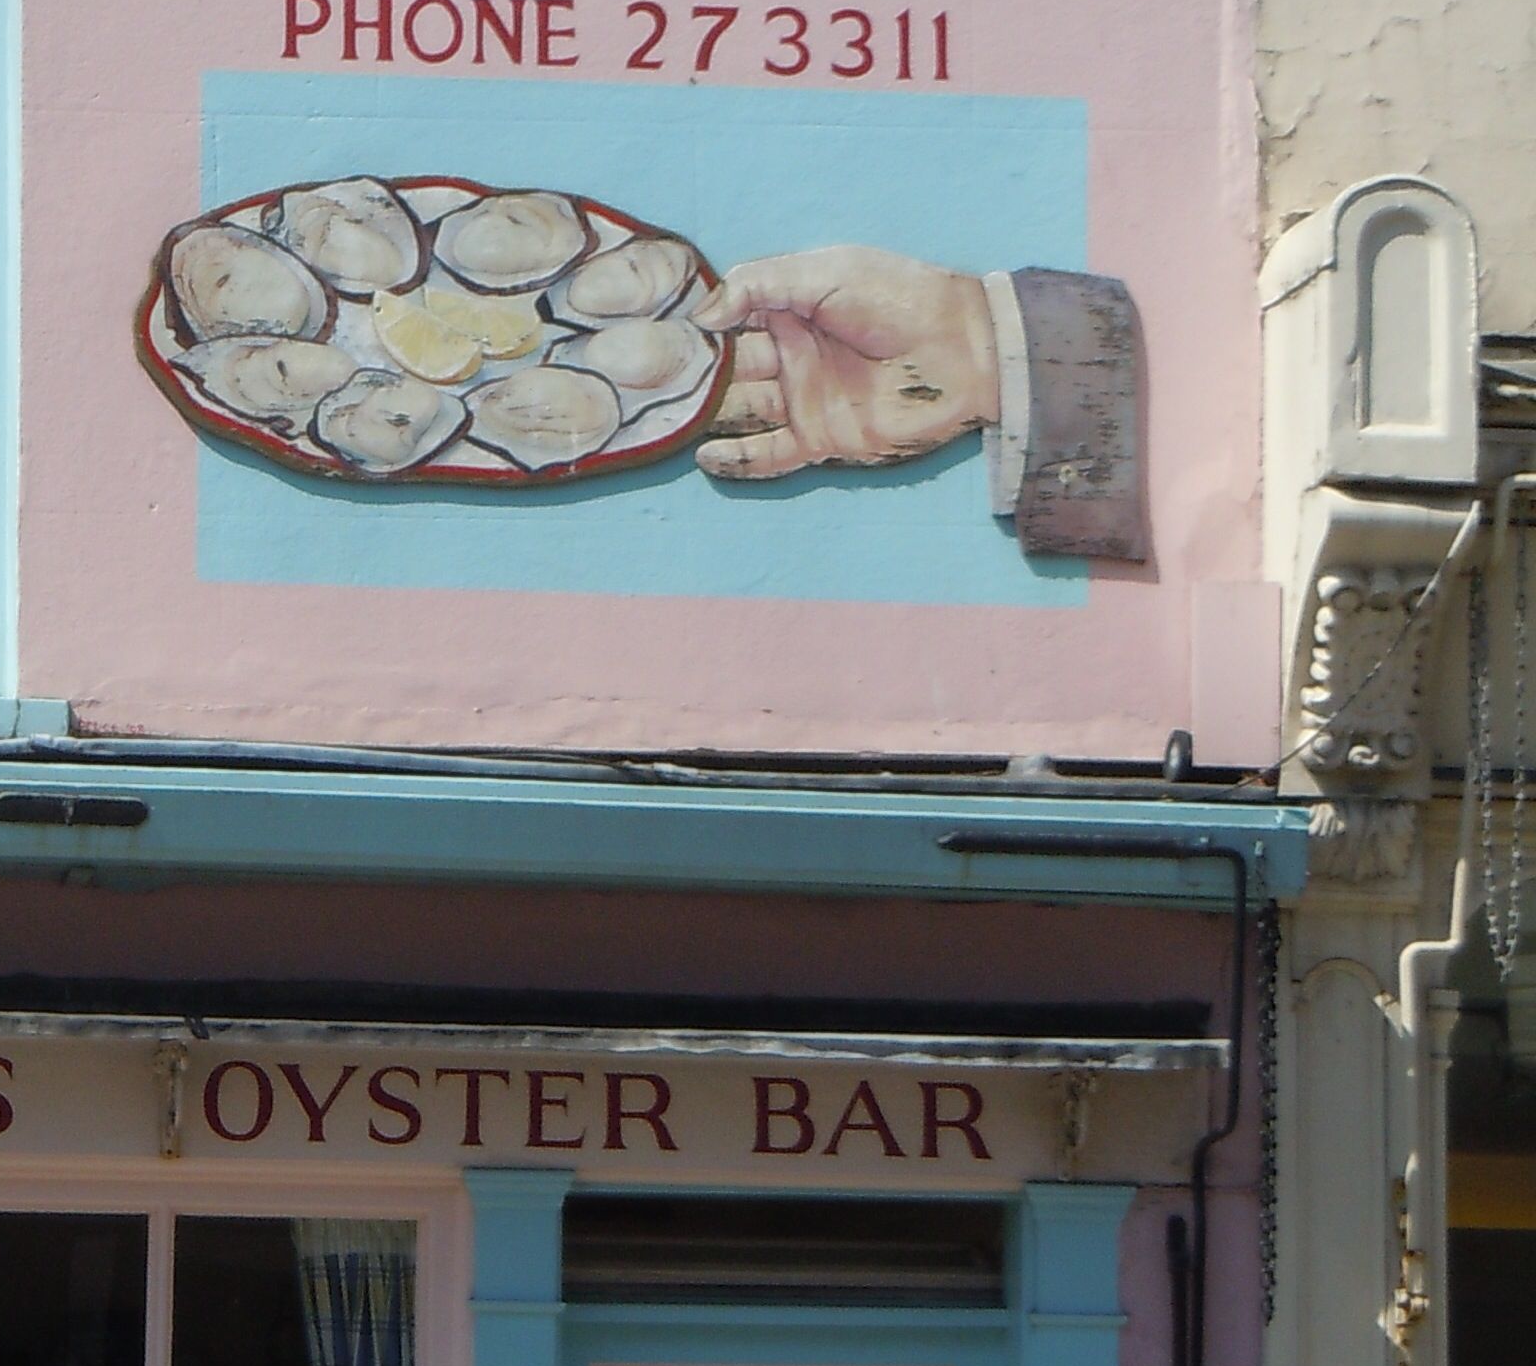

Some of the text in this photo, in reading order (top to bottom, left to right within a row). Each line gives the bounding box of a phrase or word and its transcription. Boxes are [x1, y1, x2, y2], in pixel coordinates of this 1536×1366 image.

[626, 1, 949, 81] 273311
[202, 1060, 679, 1151] OYSTER
[751, 1076, 993, 1160] BAR
